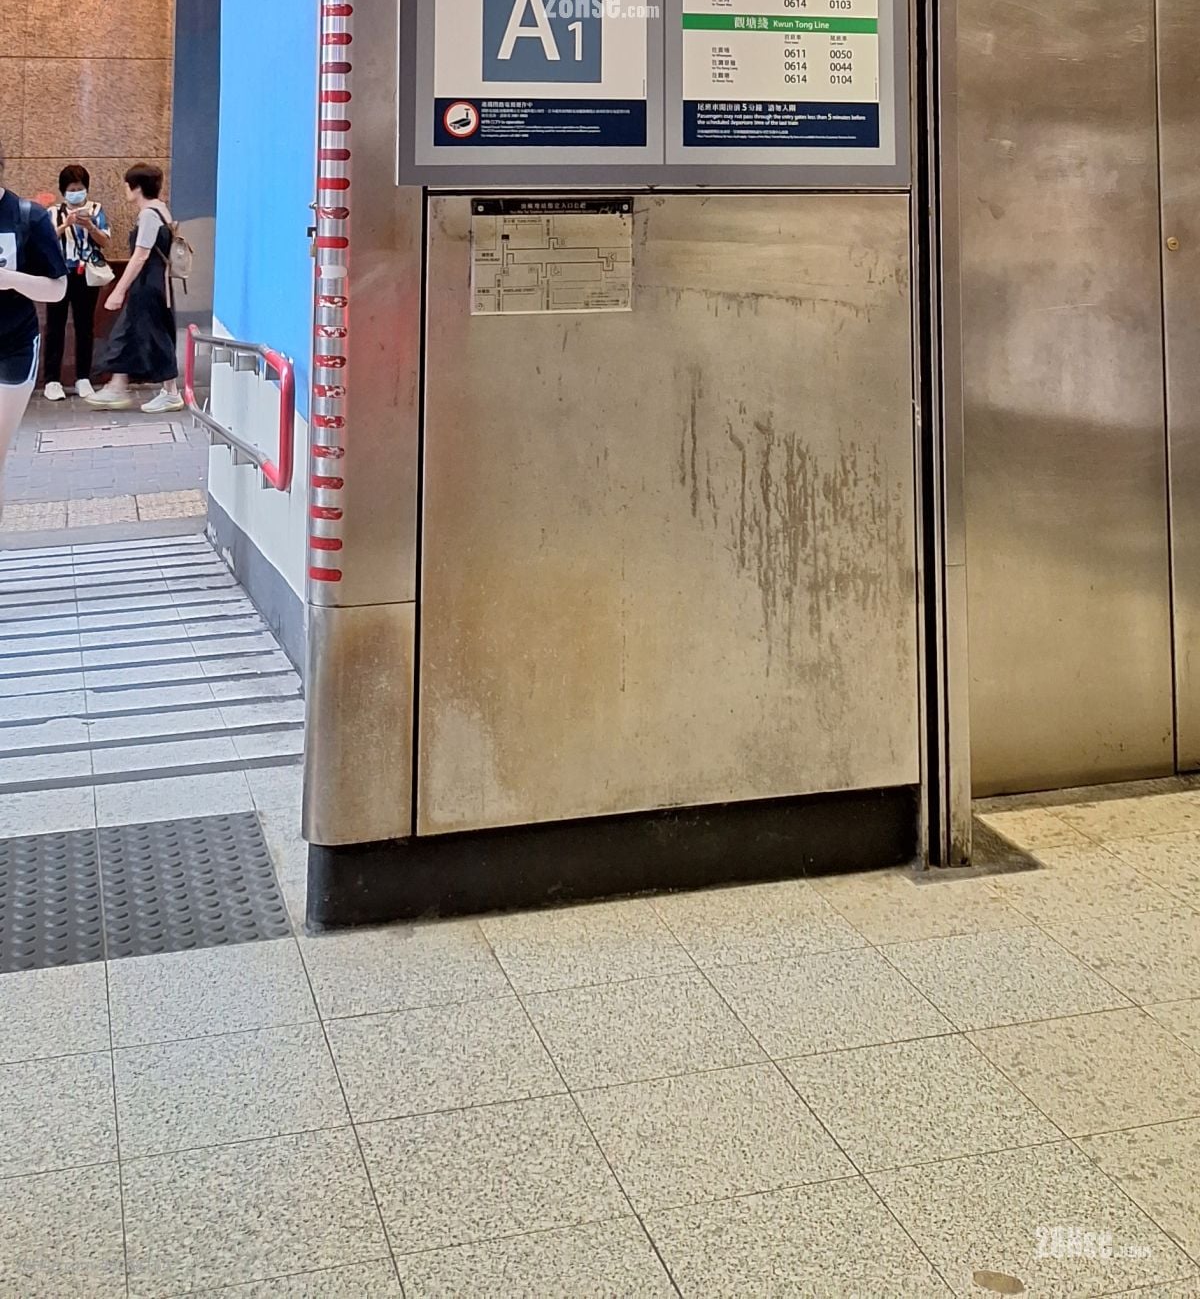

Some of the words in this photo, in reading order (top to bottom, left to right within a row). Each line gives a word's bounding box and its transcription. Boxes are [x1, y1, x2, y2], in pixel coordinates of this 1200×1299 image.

[829, 0, 852, 10] 0103
[773, 20, 794, 28] Kwun
[795, 20, 814, 30] Tong
[814, 21, 830, 29] Line
[784, 49, 806, 59] 0611
[829, 50, 853, 60] 0050
[784, 62, 807, 72] 0614
[829, 63, 853, 73] 0044
[784, 74, 807, 84] 0614
[829, 75, 853, 85] 0104
